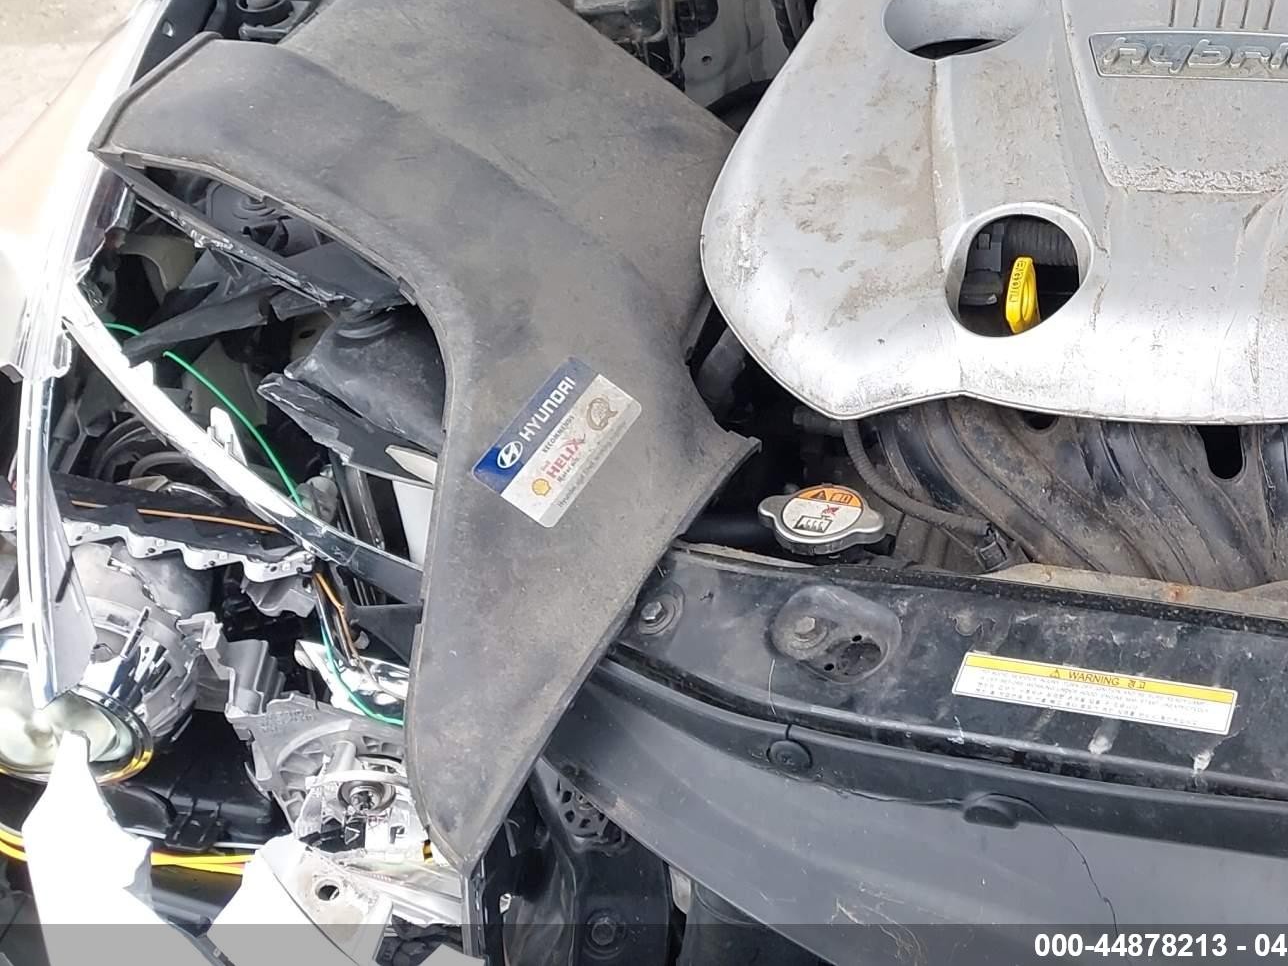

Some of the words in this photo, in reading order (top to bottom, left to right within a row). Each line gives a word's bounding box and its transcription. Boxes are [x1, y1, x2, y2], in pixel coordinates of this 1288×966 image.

[519, 376, 577, 442] HYUNDAI
[545, 434, 584, 480] HELIX
[1068, 671, 1120, 686] WARNING
